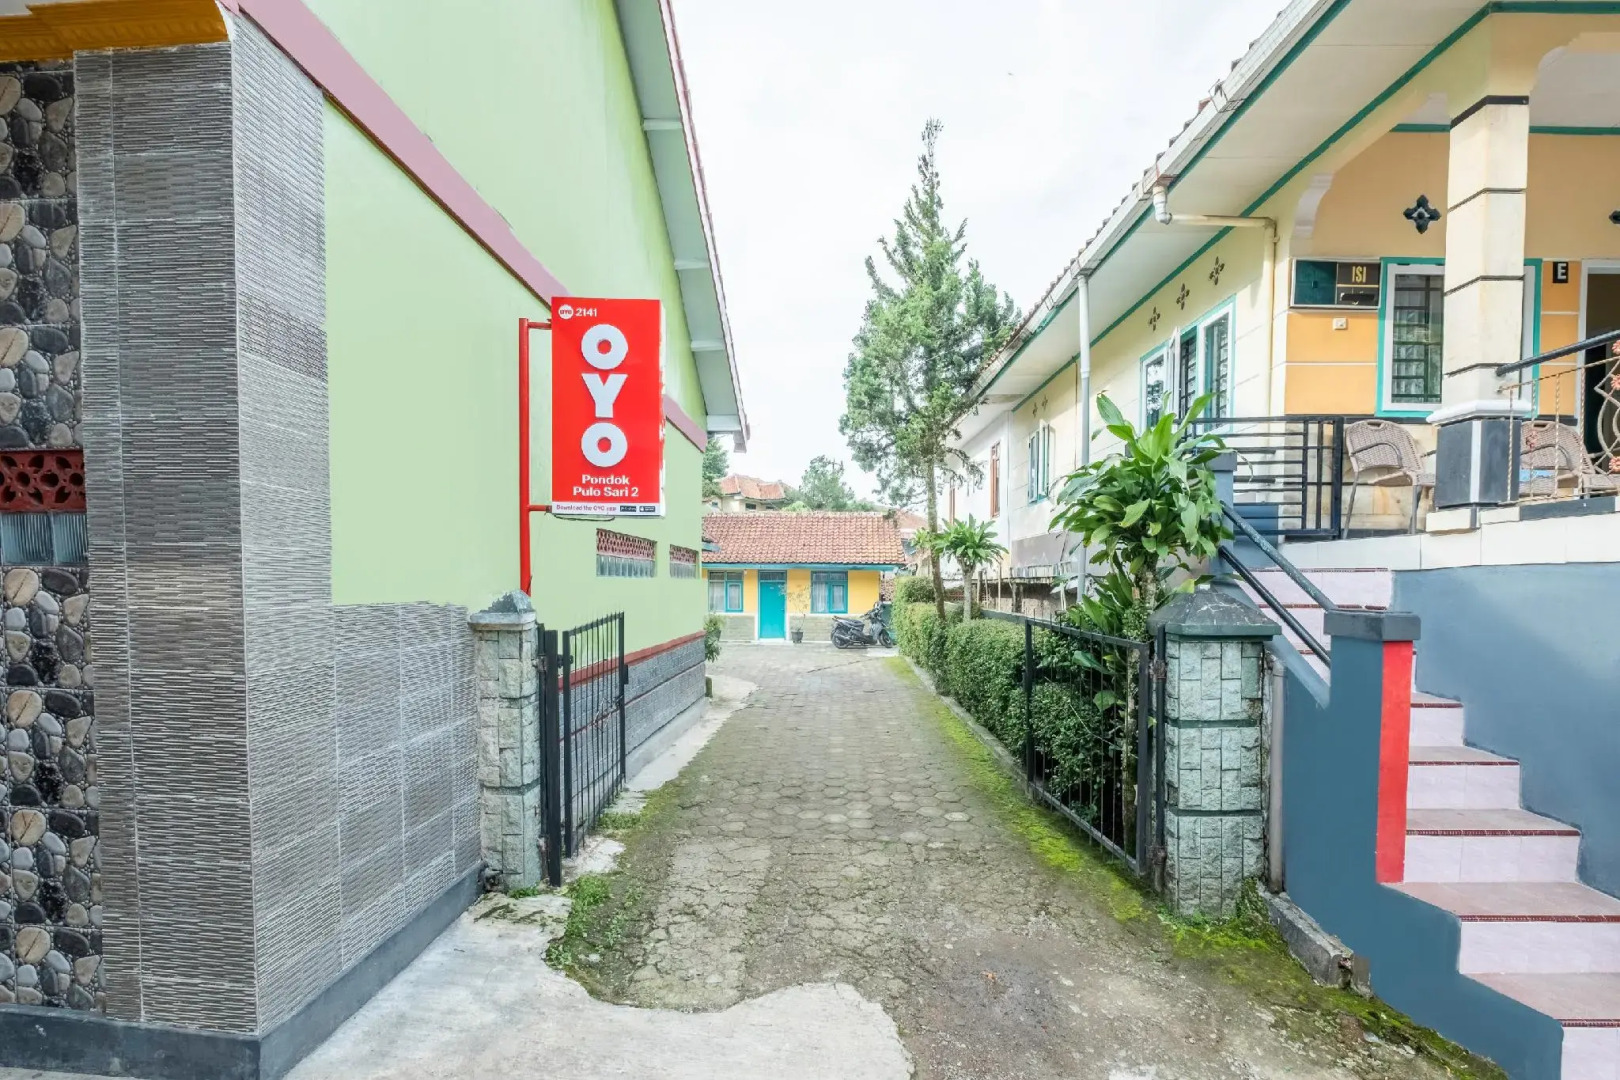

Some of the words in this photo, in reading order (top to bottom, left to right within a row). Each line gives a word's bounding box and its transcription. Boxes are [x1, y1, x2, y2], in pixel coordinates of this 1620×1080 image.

[1351, 265, 1367, 283] ISI
[1557, 262, 1567, 280] E
[575, 307, 598, 317] 2141
[580, 323, 629, 468] OYO
[581, 474, 630, 485] Pondok
[573, 486, 601, 497] Pulo
[603, 486, 629, 497] Sari
[631, 487, 639, 497] 2
